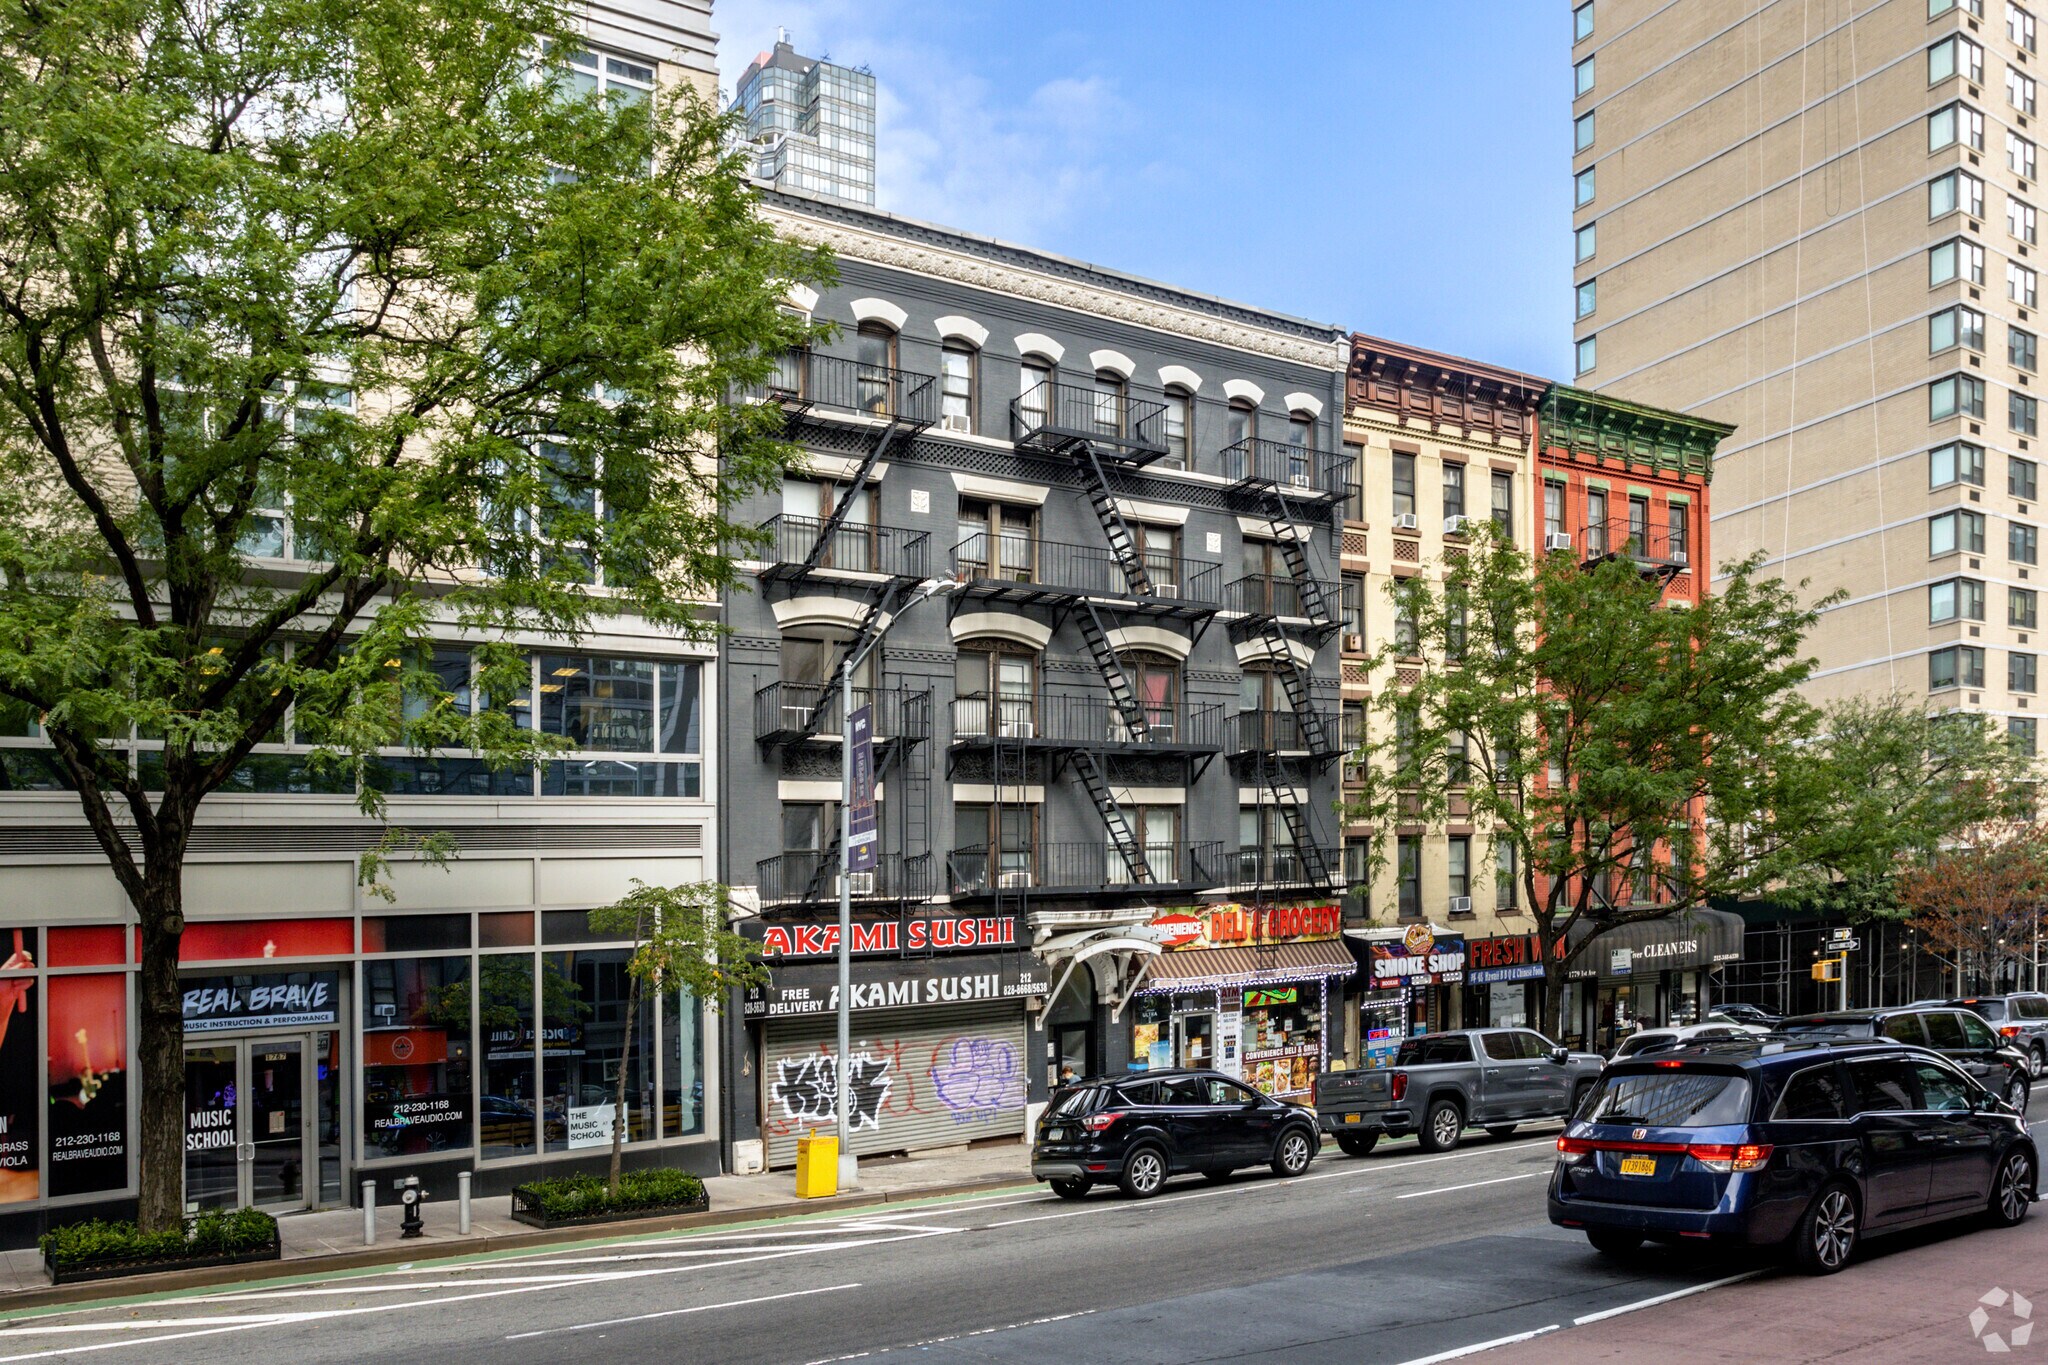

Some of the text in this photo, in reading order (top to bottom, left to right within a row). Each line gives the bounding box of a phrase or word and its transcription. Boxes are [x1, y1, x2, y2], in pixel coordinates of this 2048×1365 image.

[1150, 921, 1202, 936] NVENIENCE
[1211, 910, 1248, 941] DELI
[1268, 904, 1340, 937] GROCERY
[762, 917, 1015, 957] AKAMI SUSHI
[1470, 933, 1567, 968] FRESH WK
[1643, 940, 1697, 958] CLEANERS
[1374, 952, 1465, 978] SMOKE SHOP
[1532, 964, 1544, 976] Food
[1020, 972, 1031, 983] 212
[750, 987, 759, 999] 212
[781, 988, 810, 1000] FREE
[829, 974, 999, 1010] AKAMI SUSHI
[1003, 982, 1048, 995] 828-8668/5638
[1221, 986, 1239, 998] ATM
[183, 981, 329, 1015] REAL BRAVE
[769, 1000, 824, 1014] DELIVERY
[183, 1021, 208, 1029] MUSIC
[209, 1018, 262, 1028] INSTRUCTION
[273, 1014, 329, 1024] PERFORMANCE
[1369, 1030, 1389, 1039] OPEN
[1245, 1048, 1284, 1060] CONVENIENCE
[1284, 1046, 1297, 1054] DELI
[1303, 1043, 1319, 1052] GRILL
[393, 1100, 450, 1114] 212-230-1168
[190, 1109, 232, 1129] MUSIC
[374, 1111, 463, 1128] REALBRAVEAUDIO.COM
[570, 1112, 587, 1120] THE
[570, 1120, 598, 1130] MUSIC
[55, 1131, 121, 1147] 212-230-1168
[186, 1129, 236, 1150] SCHOOL
[570, 1130, 605, 1140] SCHOOL
[52, 1145, 123, 1161] REALBRAVEAUDIO.COM
